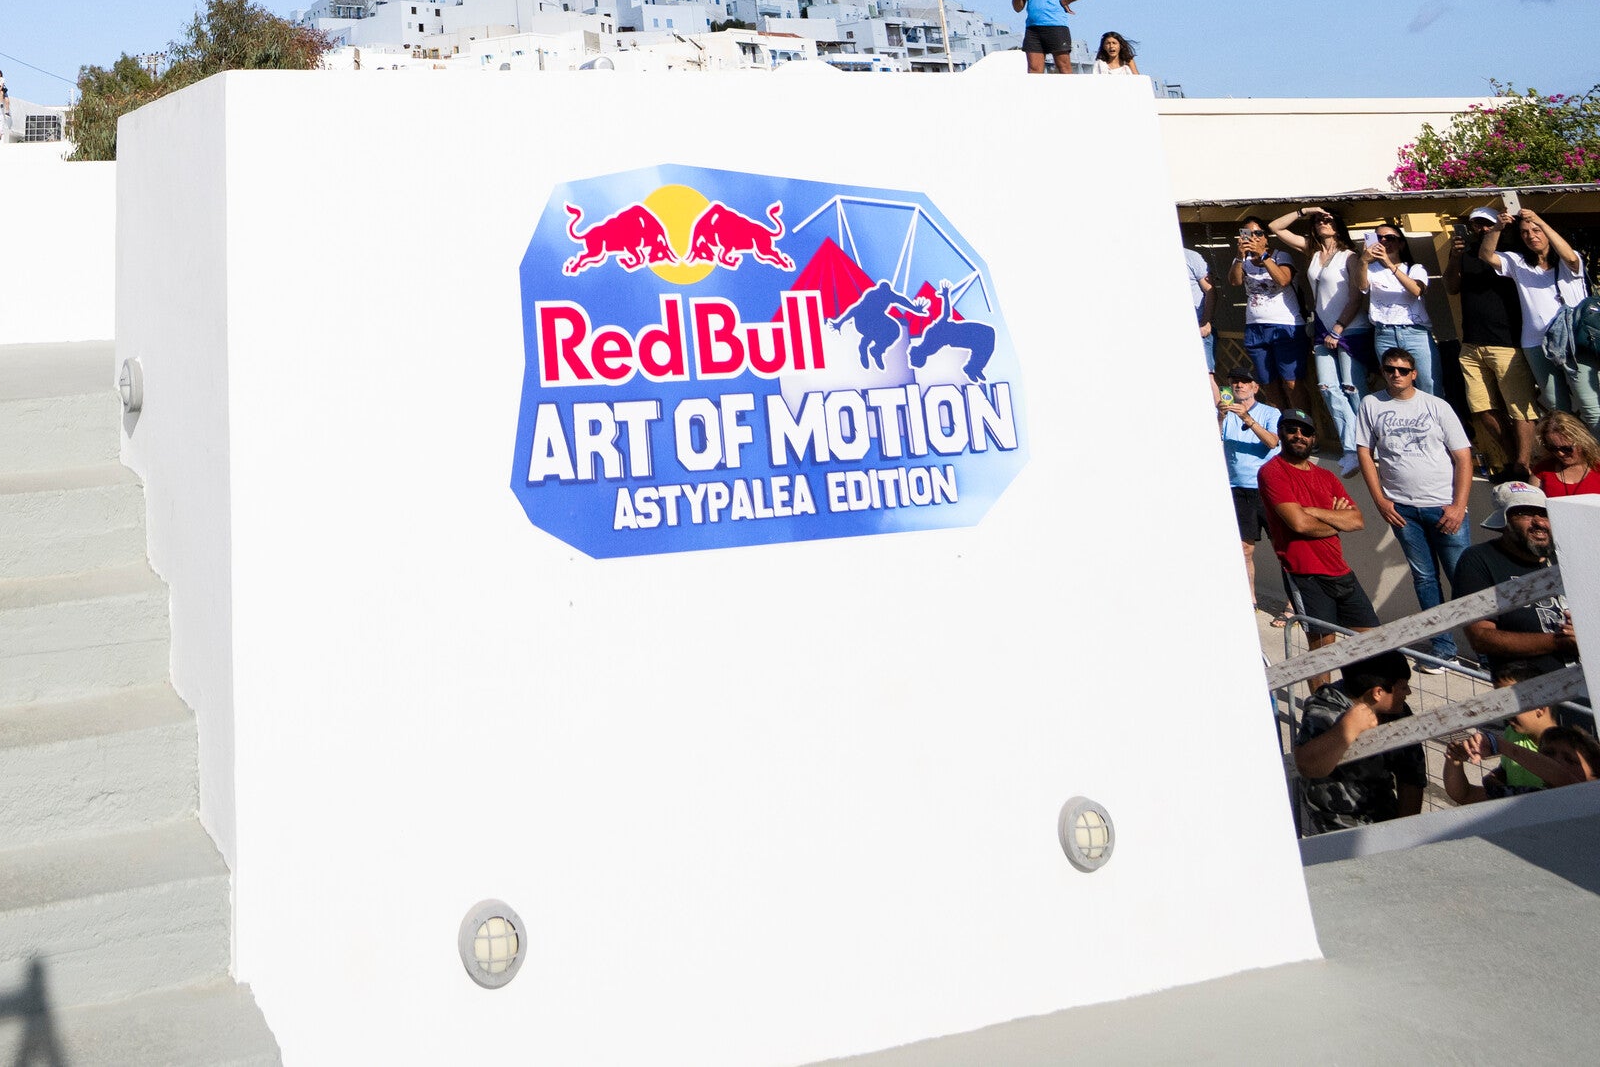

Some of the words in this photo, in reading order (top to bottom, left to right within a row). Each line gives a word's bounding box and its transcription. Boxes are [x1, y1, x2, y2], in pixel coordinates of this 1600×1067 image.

[535, 294, 687, 386] Red
[694, 290, 827, 378] Bull
[527, 399, 662, 485] ART
[676, 393, 755, 472] OF
[769, 382, 1018, 467] MOTION
[1376, 410, 1431, 436] Russell
[613, 474, 816, 531] ASTYPALEA
[828, 465, 958, 509] EDITION
